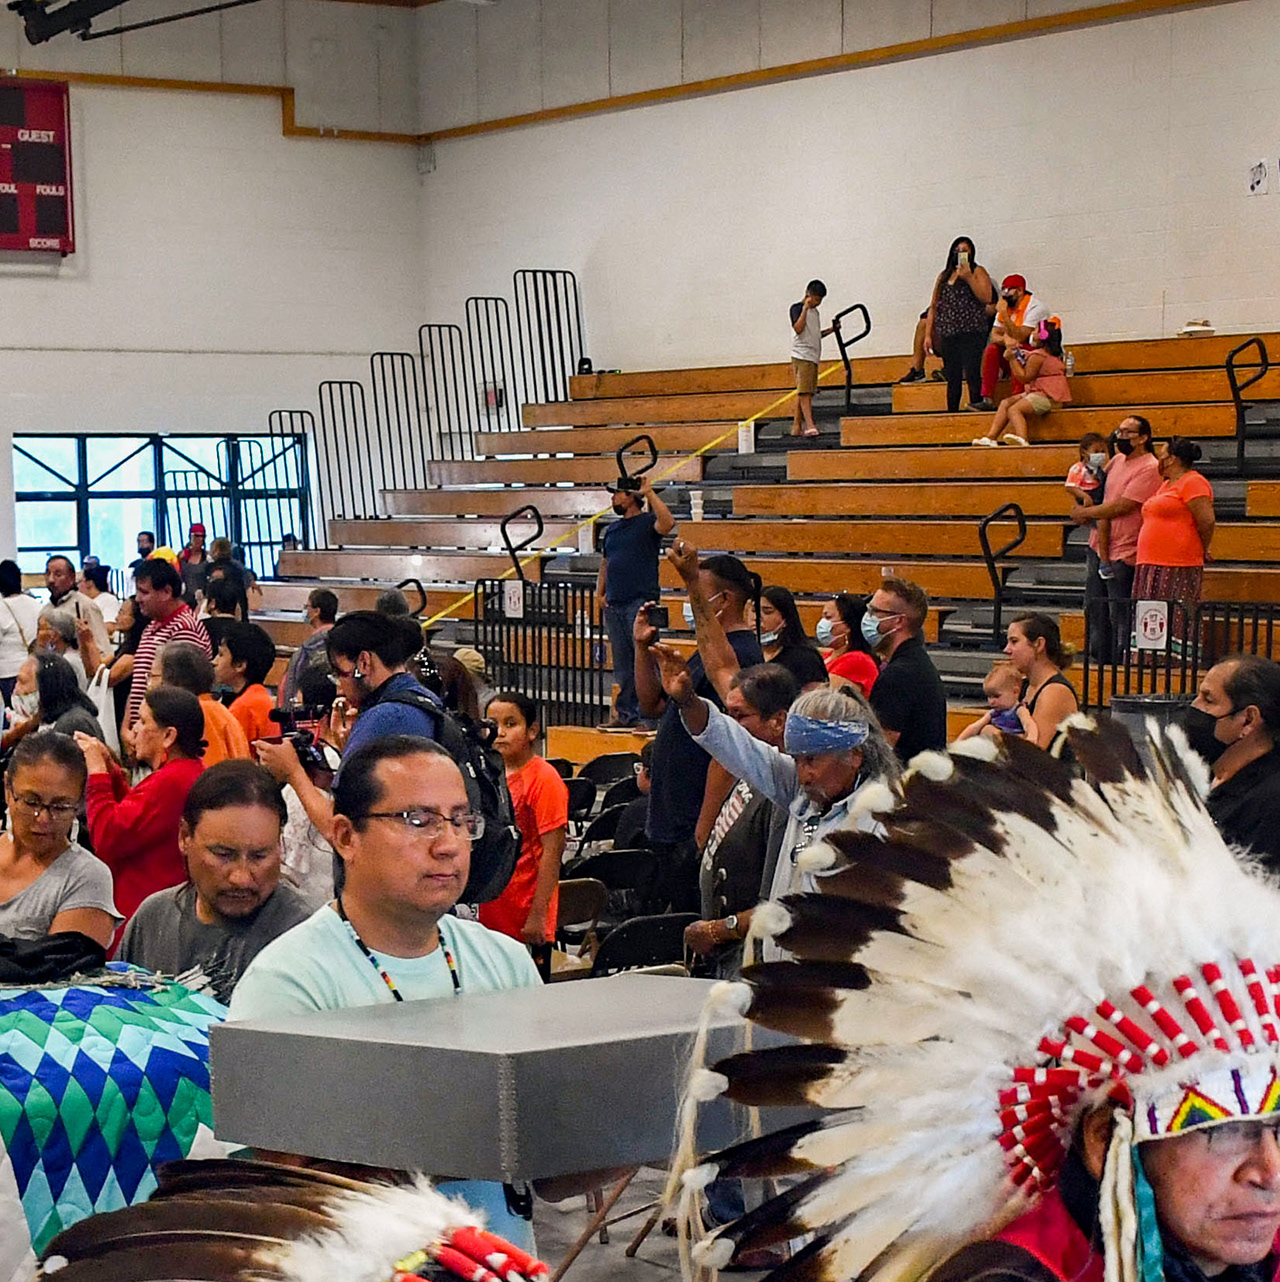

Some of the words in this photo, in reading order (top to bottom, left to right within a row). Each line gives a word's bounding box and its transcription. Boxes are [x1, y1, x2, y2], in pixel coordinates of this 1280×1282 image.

[17, 130, 56, 143] GUEST
[35, 185, 65, 196] FOULS
[28, 238, 60, 249] SCORE
